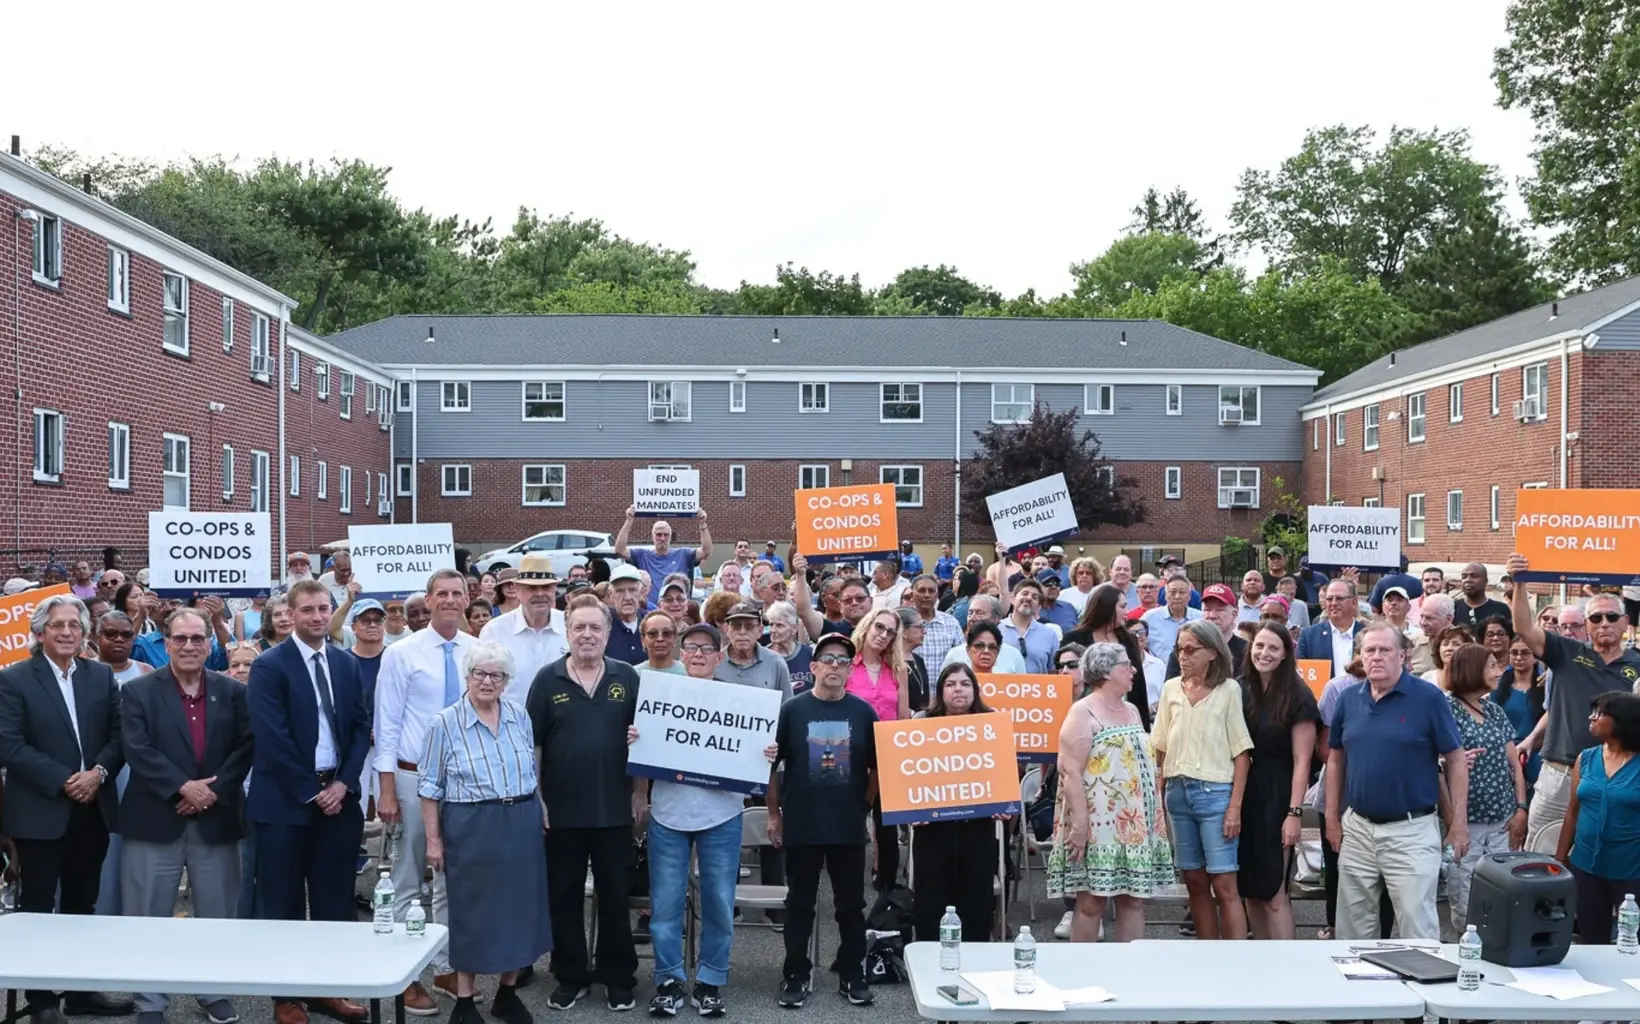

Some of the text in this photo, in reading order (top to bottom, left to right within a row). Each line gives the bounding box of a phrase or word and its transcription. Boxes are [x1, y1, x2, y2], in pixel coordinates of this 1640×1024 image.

[655, 474, 678, 484] END
[638, 488, 695, 497] UNFUNDED
[636, 501, 696, 510] MANDATES!
[807, 492, 883, 510] CO-OPS &
[992, 490, 1067, 521] AFFORDABILITY
[812, 513, 881, 530] CONDOS
[1012, 509, 1055, 530] FOR ALL!
[165, 522, 256, 536] CO-OPS &
[1310, 524, 1398, 536] AFFORDABILITY
[352, 543, 452, 556] AFFORDABILITY
[816, 535, 878, 551] UNITED!
[1329, 539, 1378, 550] FOR ALL!
[1545, 536, 1616, 551] FOR ALL!
[169, 546, 252, 560] CONDOS
[376, 561, 432, 573] FOR ALL!
[174, 570, 247, 584] UNITED!
[1307, 668, 1317, 681] &
[979, 682, 1058, 698] O-OPS &
[638, 699, 776, 733] AFFORDABILITY
[665, 728, 741, 753] FOR ALL!
[893, 723, 997, 748] CO-OPS &
[1014, 732, 1048, 748] TED!
[900, 751, 996, 777] CONDOS
[907, 781, 992, 804] UNITED!
